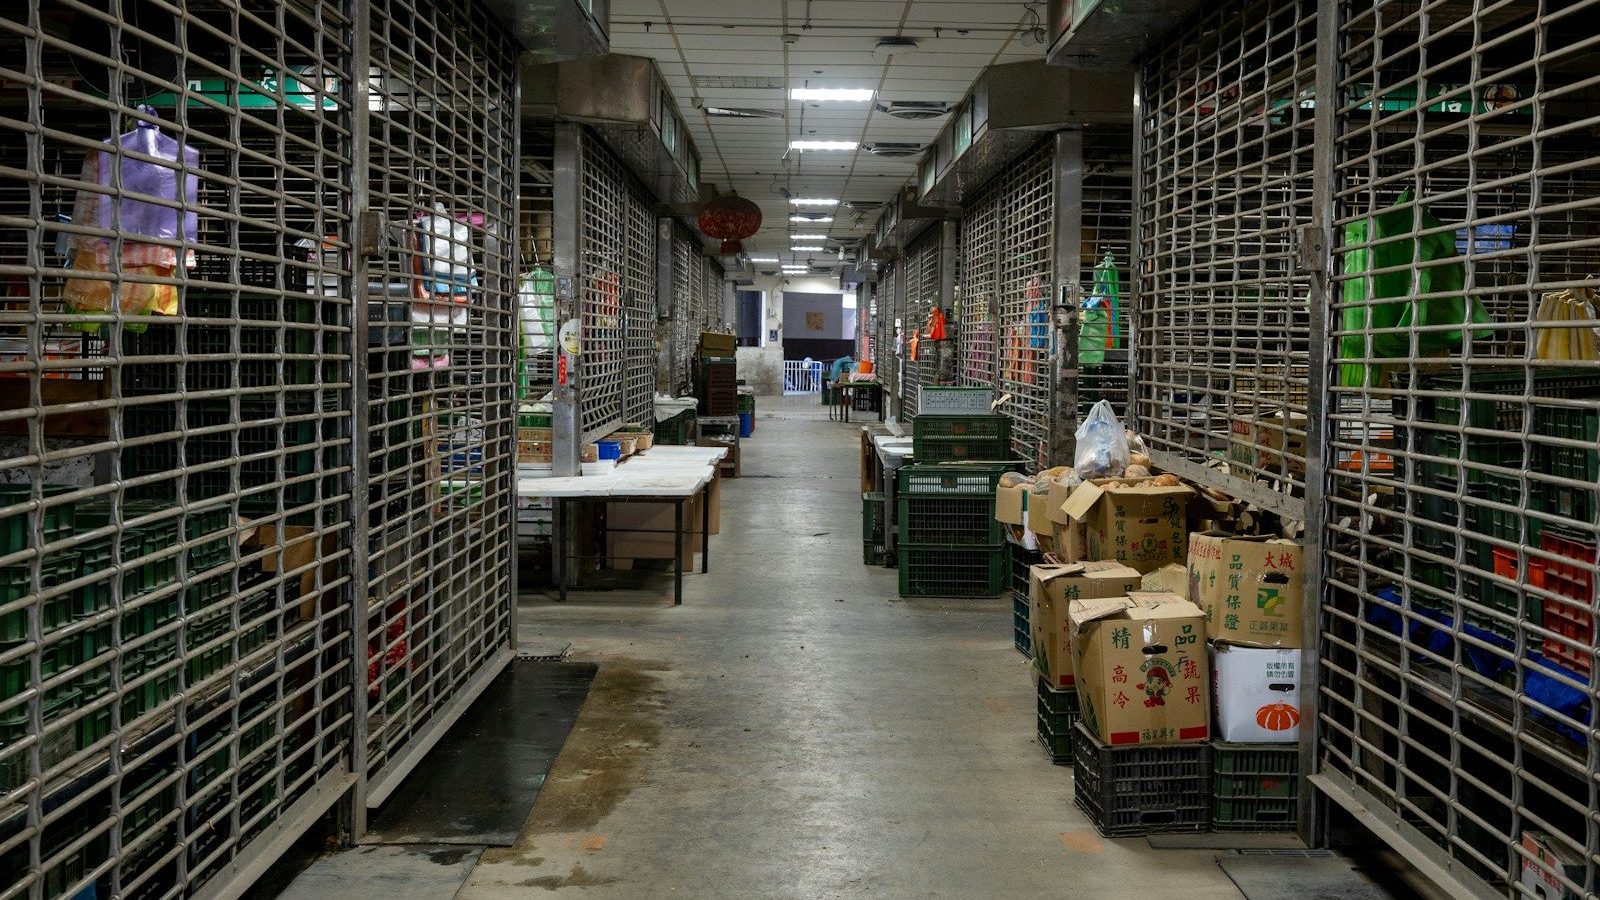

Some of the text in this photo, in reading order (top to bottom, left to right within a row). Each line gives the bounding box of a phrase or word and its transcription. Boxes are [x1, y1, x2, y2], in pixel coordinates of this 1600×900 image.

[1223, 554, 1243, 630] 品質保證
[1111, 624, 1197, 650] 精 品
[1112, 665, 1131, 709] 高冷
[1183, 660, 1201, 704] 蔬果
[1266, 662, 1295, 670] 版權所有
